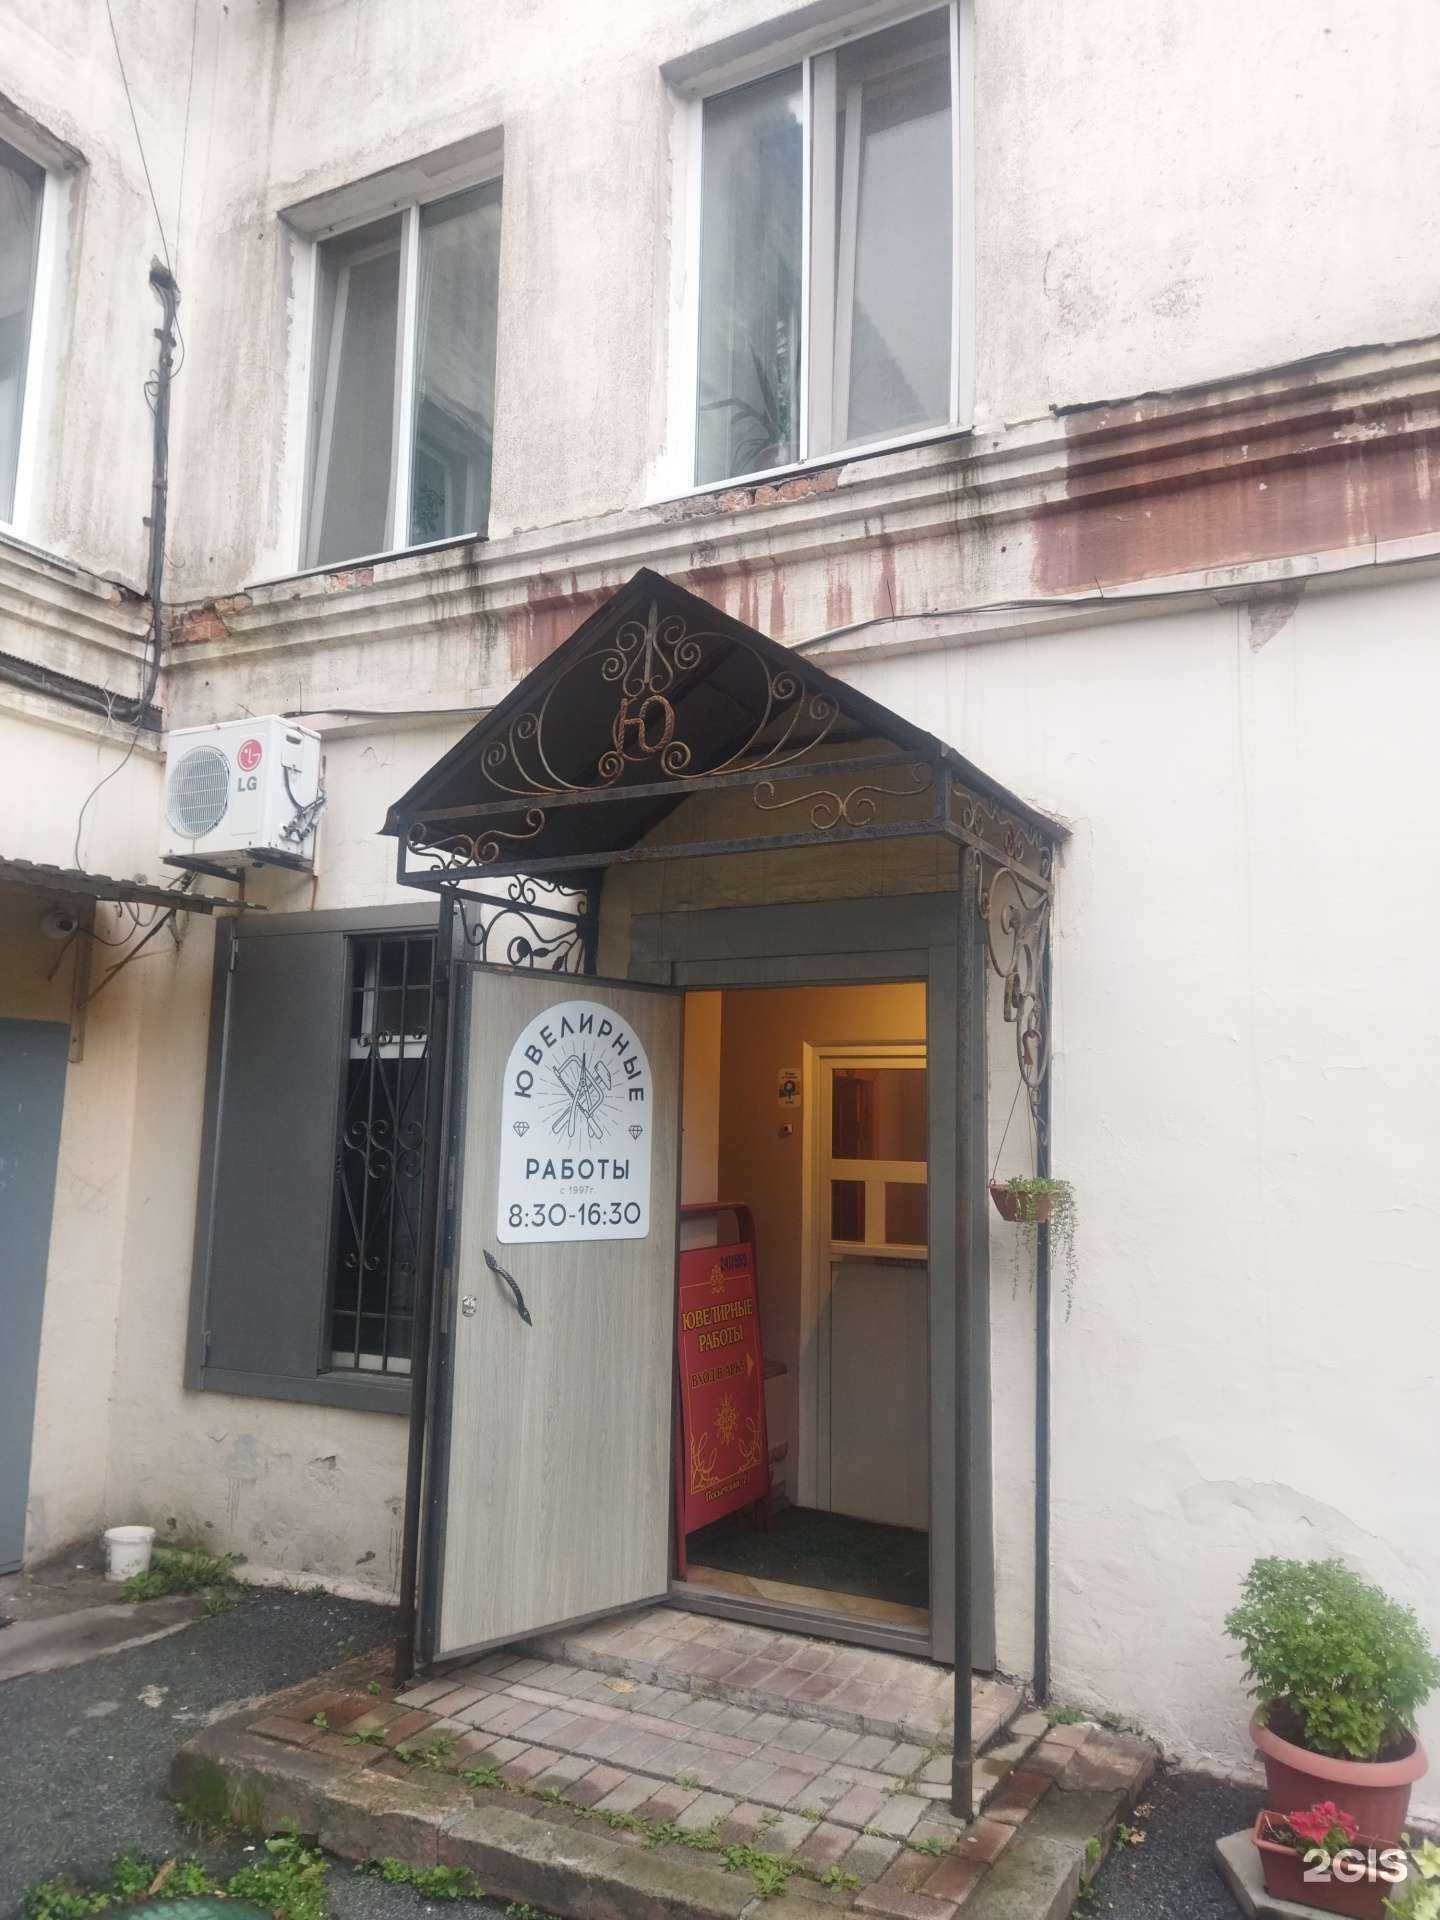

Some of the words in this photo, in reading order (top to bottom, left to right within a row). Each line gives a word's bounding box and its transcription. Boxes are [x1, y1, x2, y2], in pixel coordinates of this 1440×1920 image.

[237, 776, 258, 793] LG
[514, 1012, 644, 1102] ЮВЕЛИРНЫЕ
[525, 1158, 630, 1180] РАБОТЫ
[508, 1202, 642, 1228] 8:30-16:30
[682, 1297, 753, 1331] ЮВЕЛИРНЫЕ
[698, 1324, 744, 1352] РАБОТЫ
